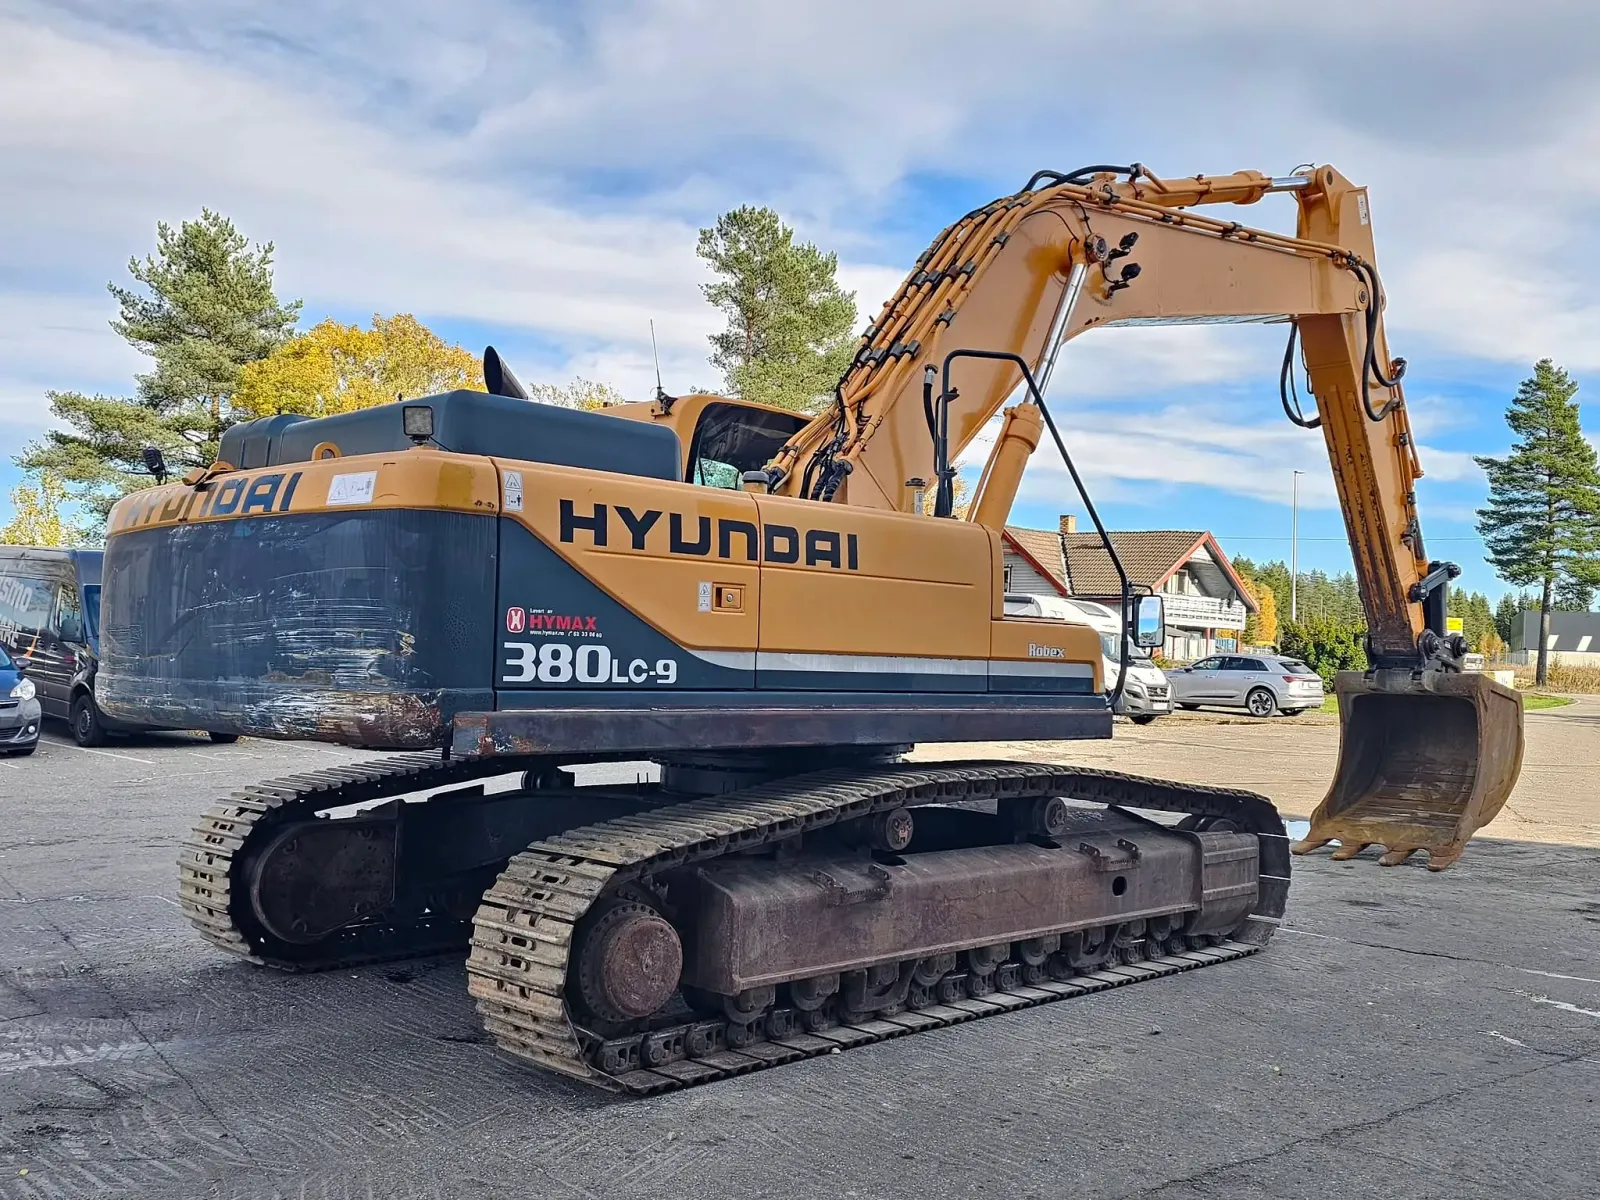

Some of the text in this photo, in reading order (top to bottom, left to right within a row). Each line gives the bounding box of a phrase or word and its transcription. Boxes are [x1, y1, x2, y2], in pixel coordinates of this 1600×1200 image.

[559, 498, 858, 570] HYUNDAI
[530, 615, 597, 630] HYMAX
[1028, 644, 1065, 657] Robex
